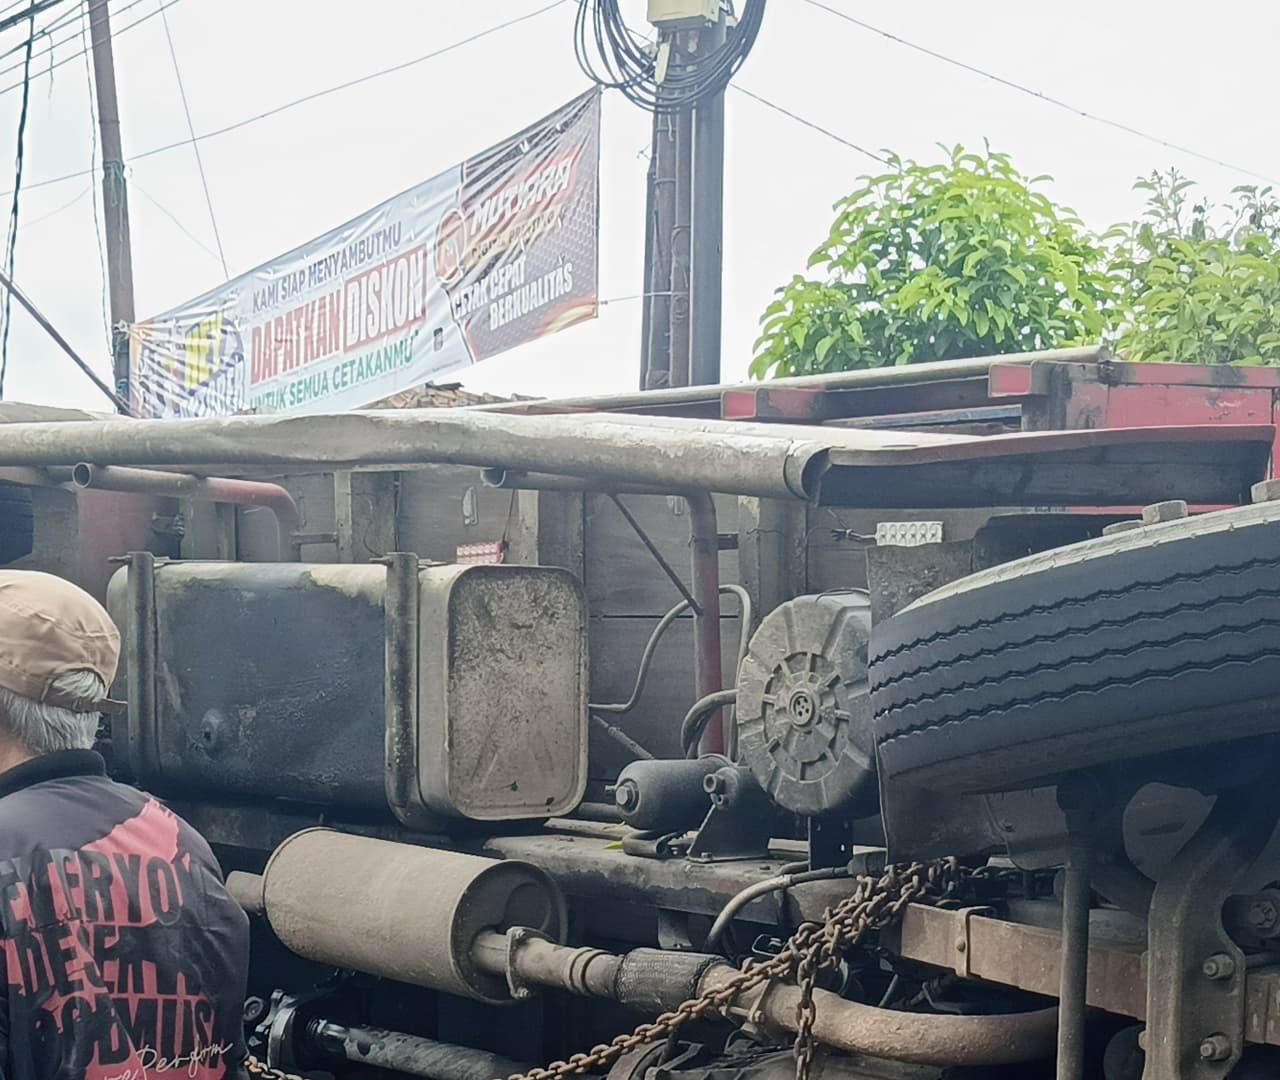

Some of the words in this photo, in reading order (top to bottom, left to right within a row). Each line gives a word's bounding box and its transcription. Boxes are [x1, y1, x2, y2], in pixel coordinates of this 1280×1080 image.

[252, 279, 279, 313] KAMI
[280, 271, 306, 300] SIAP
[307, 221, 402, 288] MENYAMBUTMU
[489, 255, 527, 299] CEPAT
[489, 262, 573, 331] BERKUALITAS
[251, 289, 341, 385] DAPATKAN
[346, 248, 426, 347] DISKON
[289, 370, 329, 406] SEMUA
